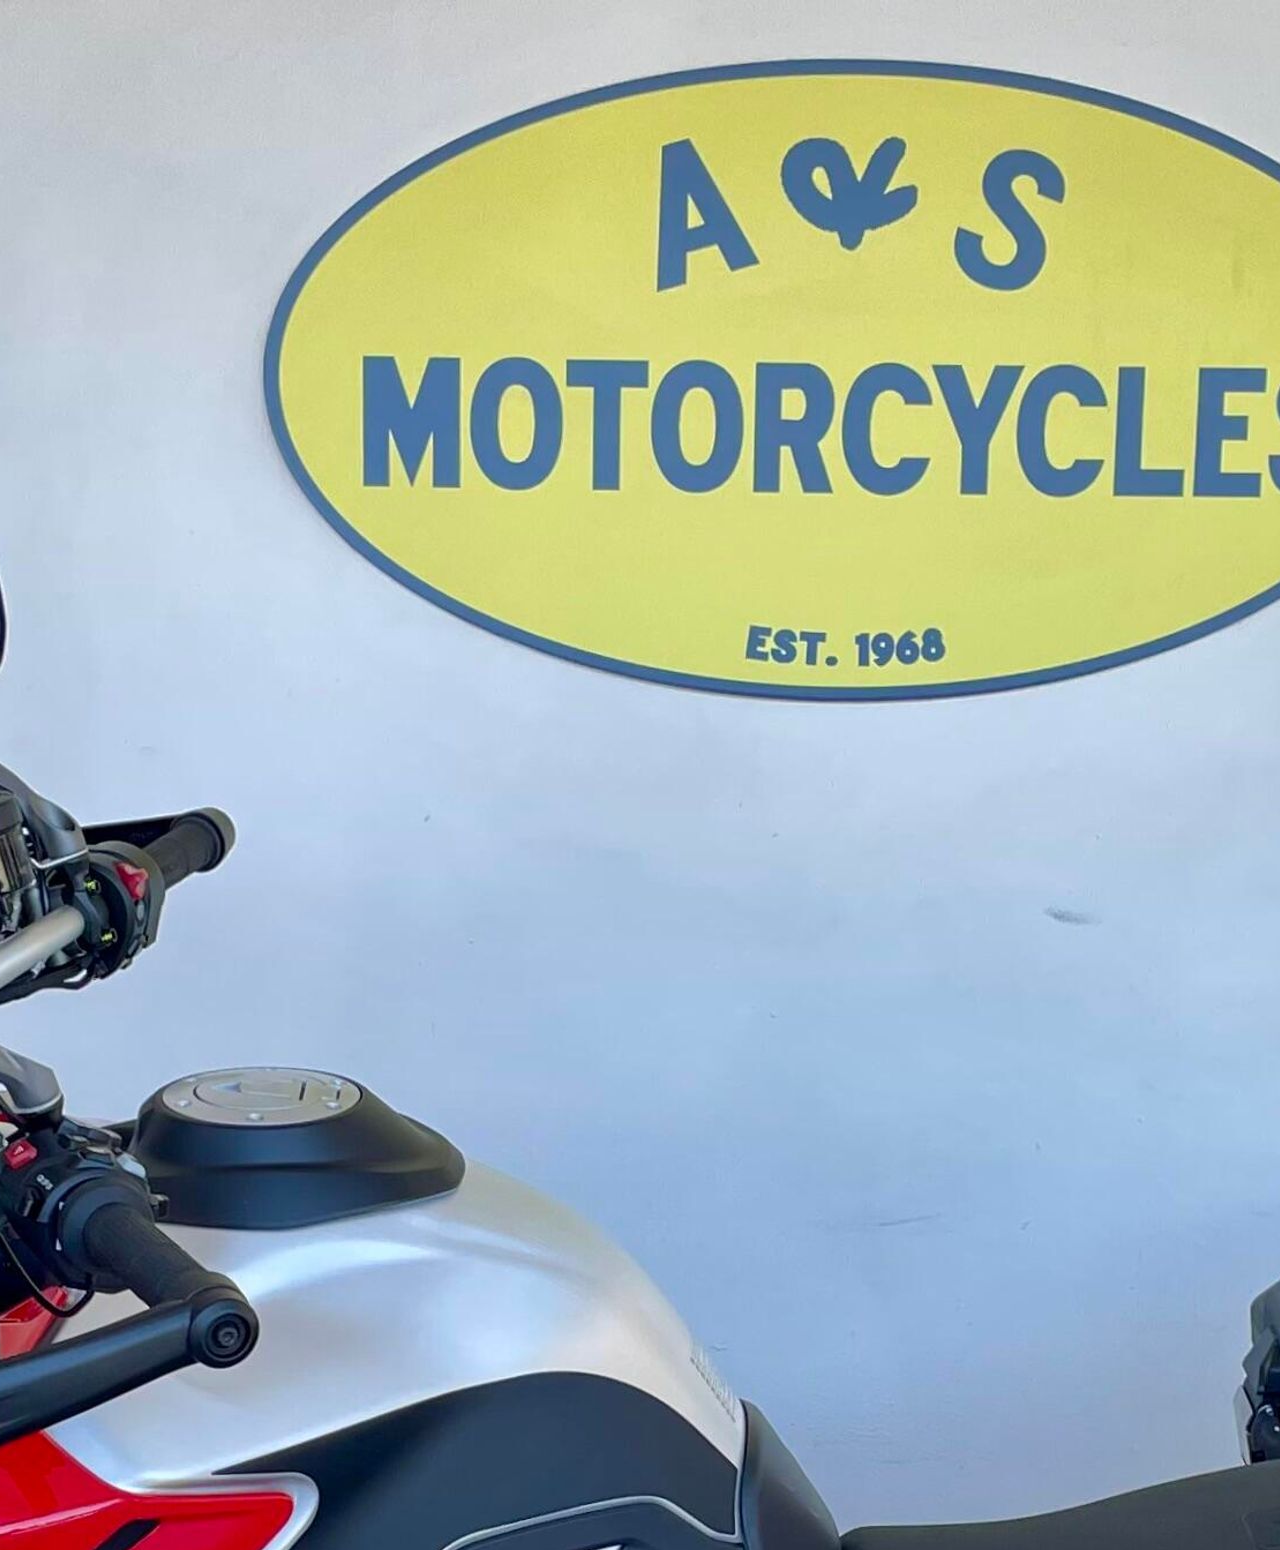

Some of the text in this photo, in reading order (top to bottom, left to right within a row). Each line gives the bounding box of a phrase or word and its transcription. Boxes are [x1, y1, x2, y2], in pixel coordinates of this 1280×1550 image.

[657, 138, 758, 291] A
[954, 149, 1065, 290] S
[746, 625, 946, 667] EST. 1968
